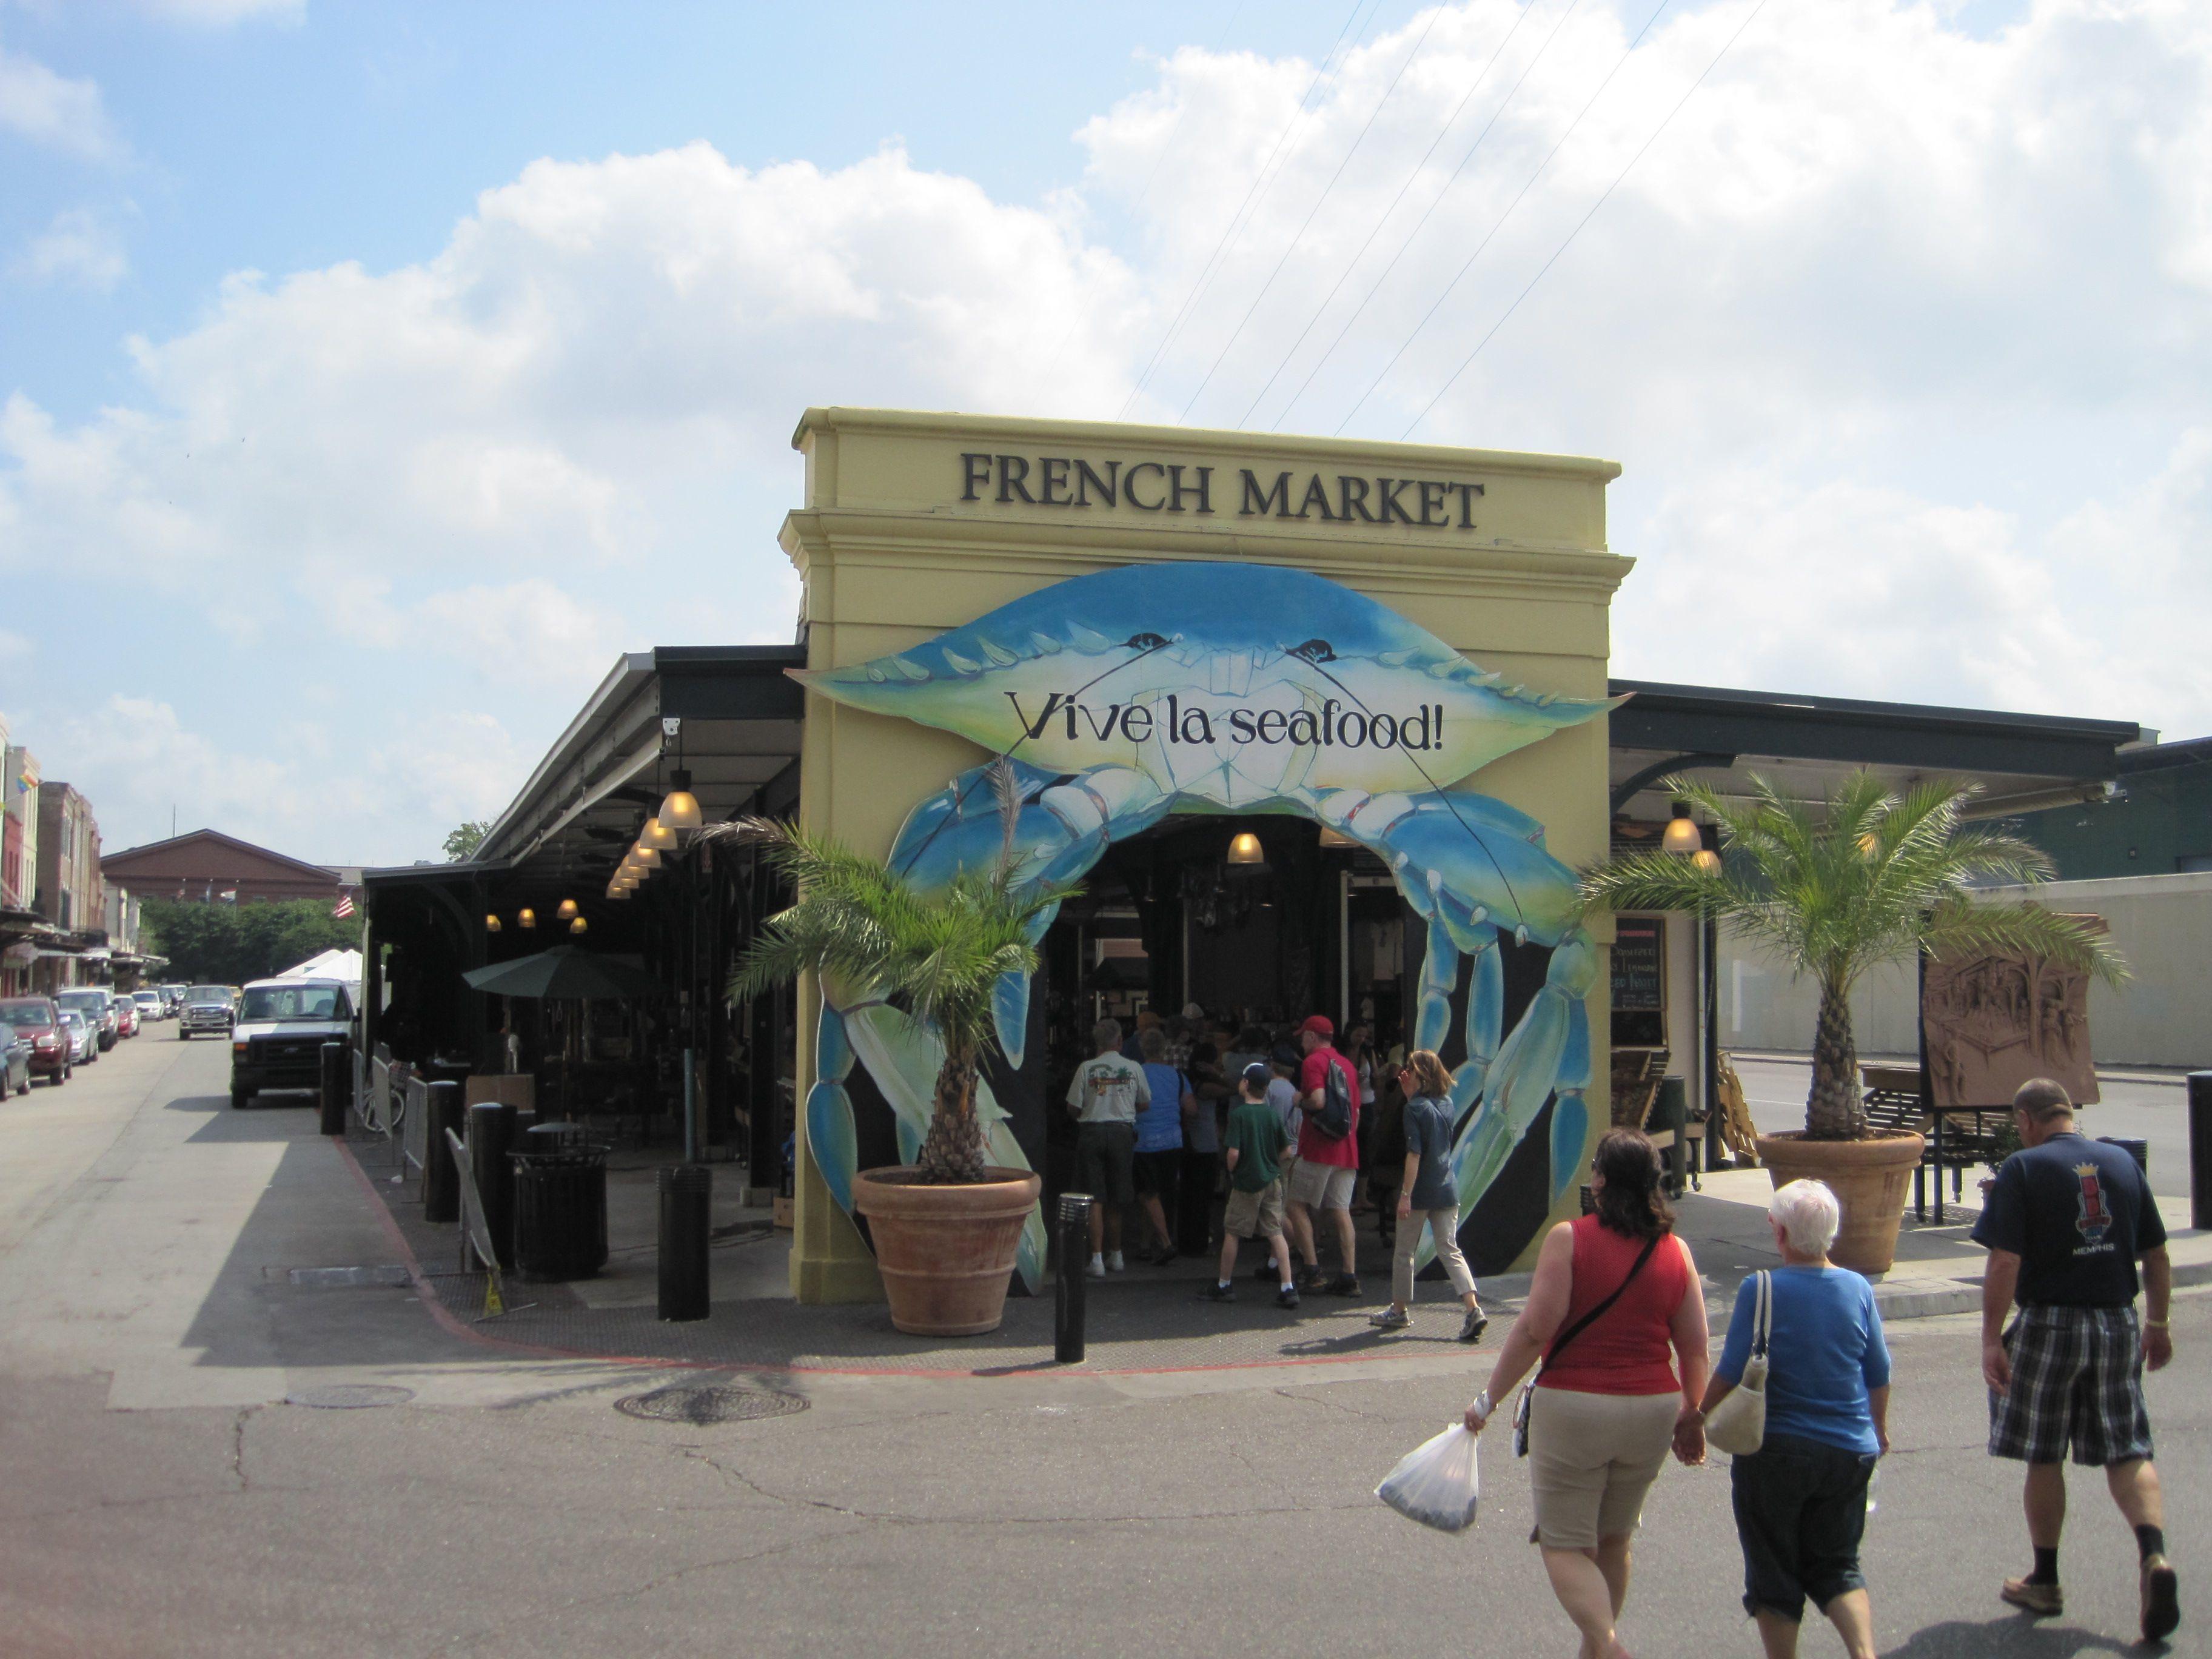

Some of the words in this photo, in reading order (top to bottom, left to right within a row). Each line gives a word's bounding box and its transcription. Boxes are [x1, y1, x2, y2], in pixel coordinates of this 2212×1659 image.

[960, 453, 1216, 513] FRENCH
[1238, 469, 1485, 529] MARKET
[1004, 691, 1153, 742] Vive
[1167, 694, 1216, 744] la
[1230, 699, 1443, 751] seafood!
[2072, 1243, 2115, 1256] MEMPHIS
